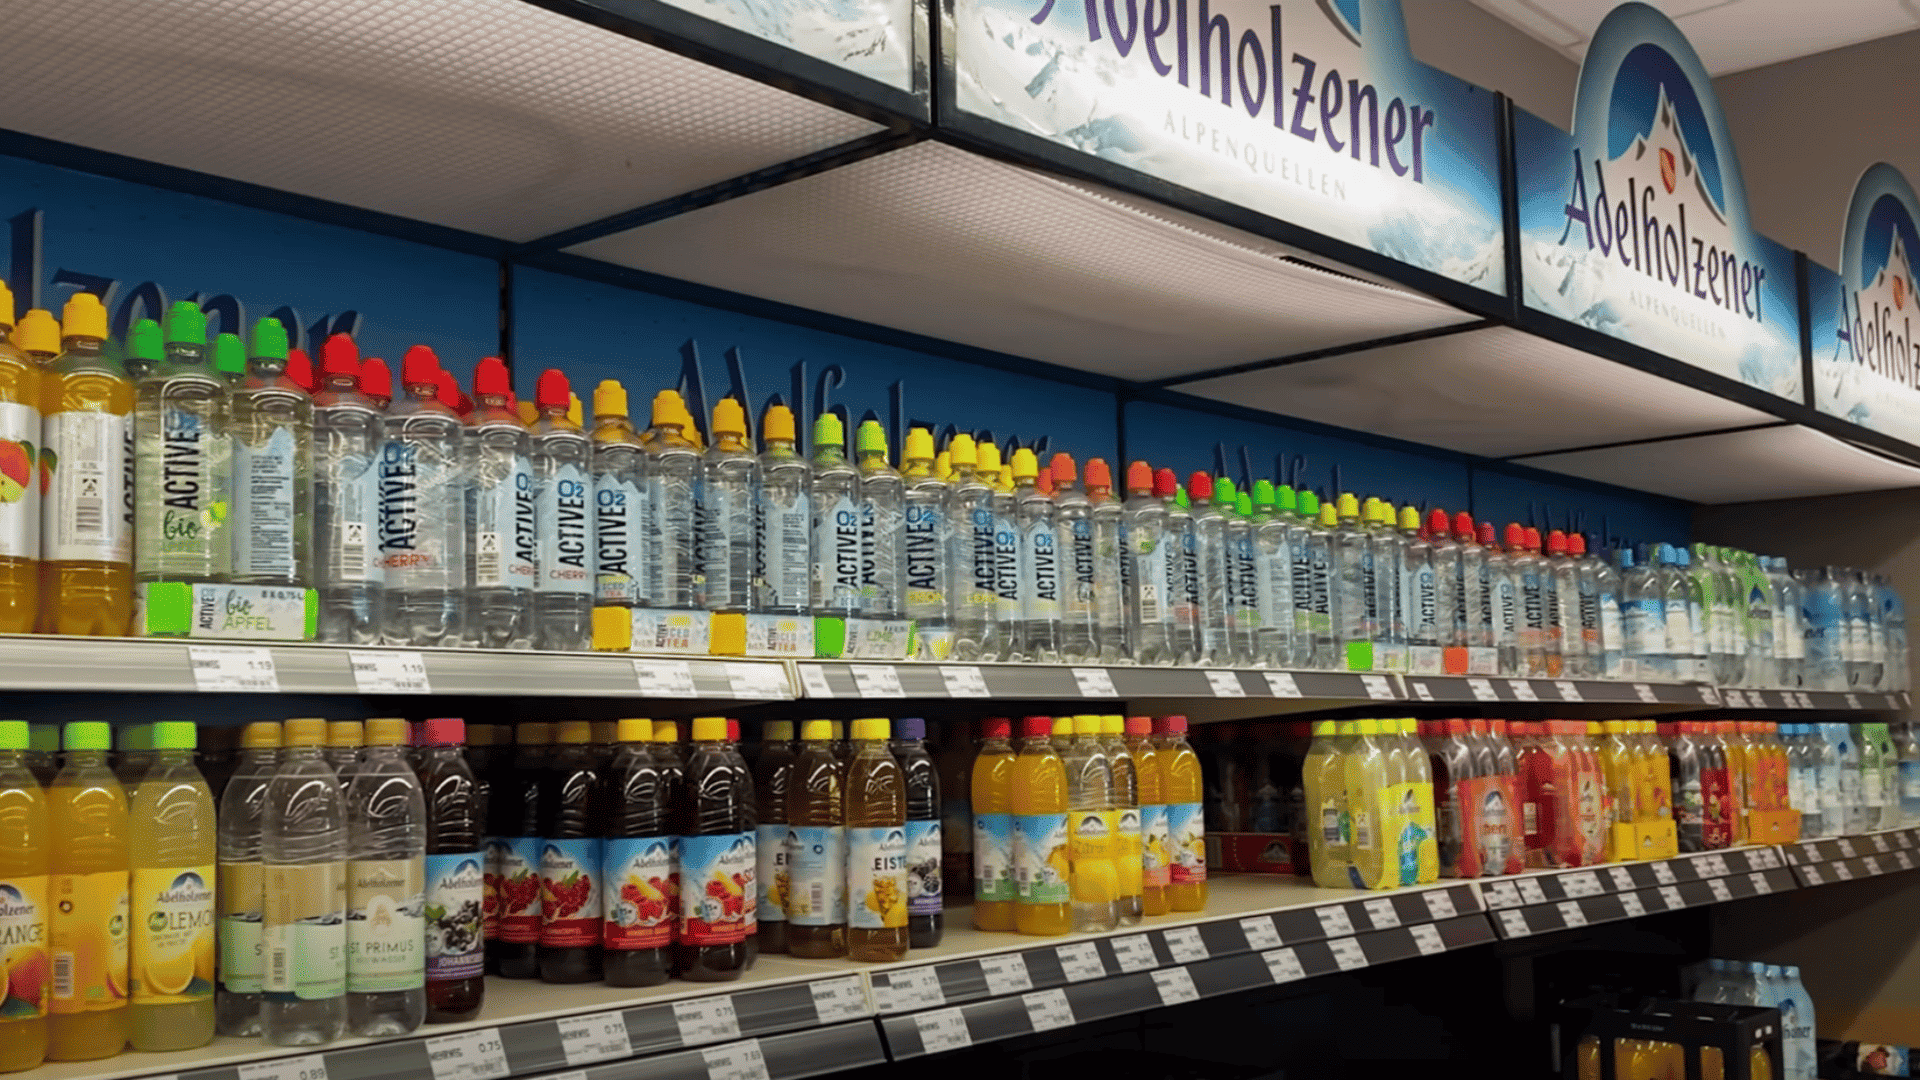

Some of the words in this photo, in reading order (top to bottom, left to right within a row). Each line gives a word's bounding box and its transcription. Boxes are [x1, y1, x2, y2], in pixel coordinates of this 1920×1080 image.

[1164, 109, 1346, 201] ALPENQUELLEN
[1558, 148, 1765, 323] Adelholzener
[164, 432, 199, 510] ACTIVE
[557, 479, 585, 499] O2
[384, 465, 416, 550] ACTIVE
[596, 489, 626, 507] O2
[163, 510, 200, 540] bio
[516, 491, 533, 563] ACTIVE
[557, 498, 584, 568] ACTIVE
[597, 507, 627, 574] ACTIVE
[837, 527, 859, 589] ACTIVE
[906, 523, 936, 590] ACTIVE
[973, 526, 996, 593] ACTIVE
[996, 546, 1018, 601] ACTIVE
[1035, 547, 1056, 601] ACTIVE
[1074, 534, 1095, 585] ACTIVE
[199, 594, 215, 630] ACTIVE
[222, 616, 276, 631] APFEL
[225, 590, 252, 616] bio
[1524, 585, 1543, 630] ACTIVE
[402, 664, 424, 674] 1.19
[0, 922, 44, 945] ANGE
[365, 939, 415, 955] PRIMUS
[478, 1040, 501, 1053] 0.75
[603, 1023, 625, 1035] 0.75
